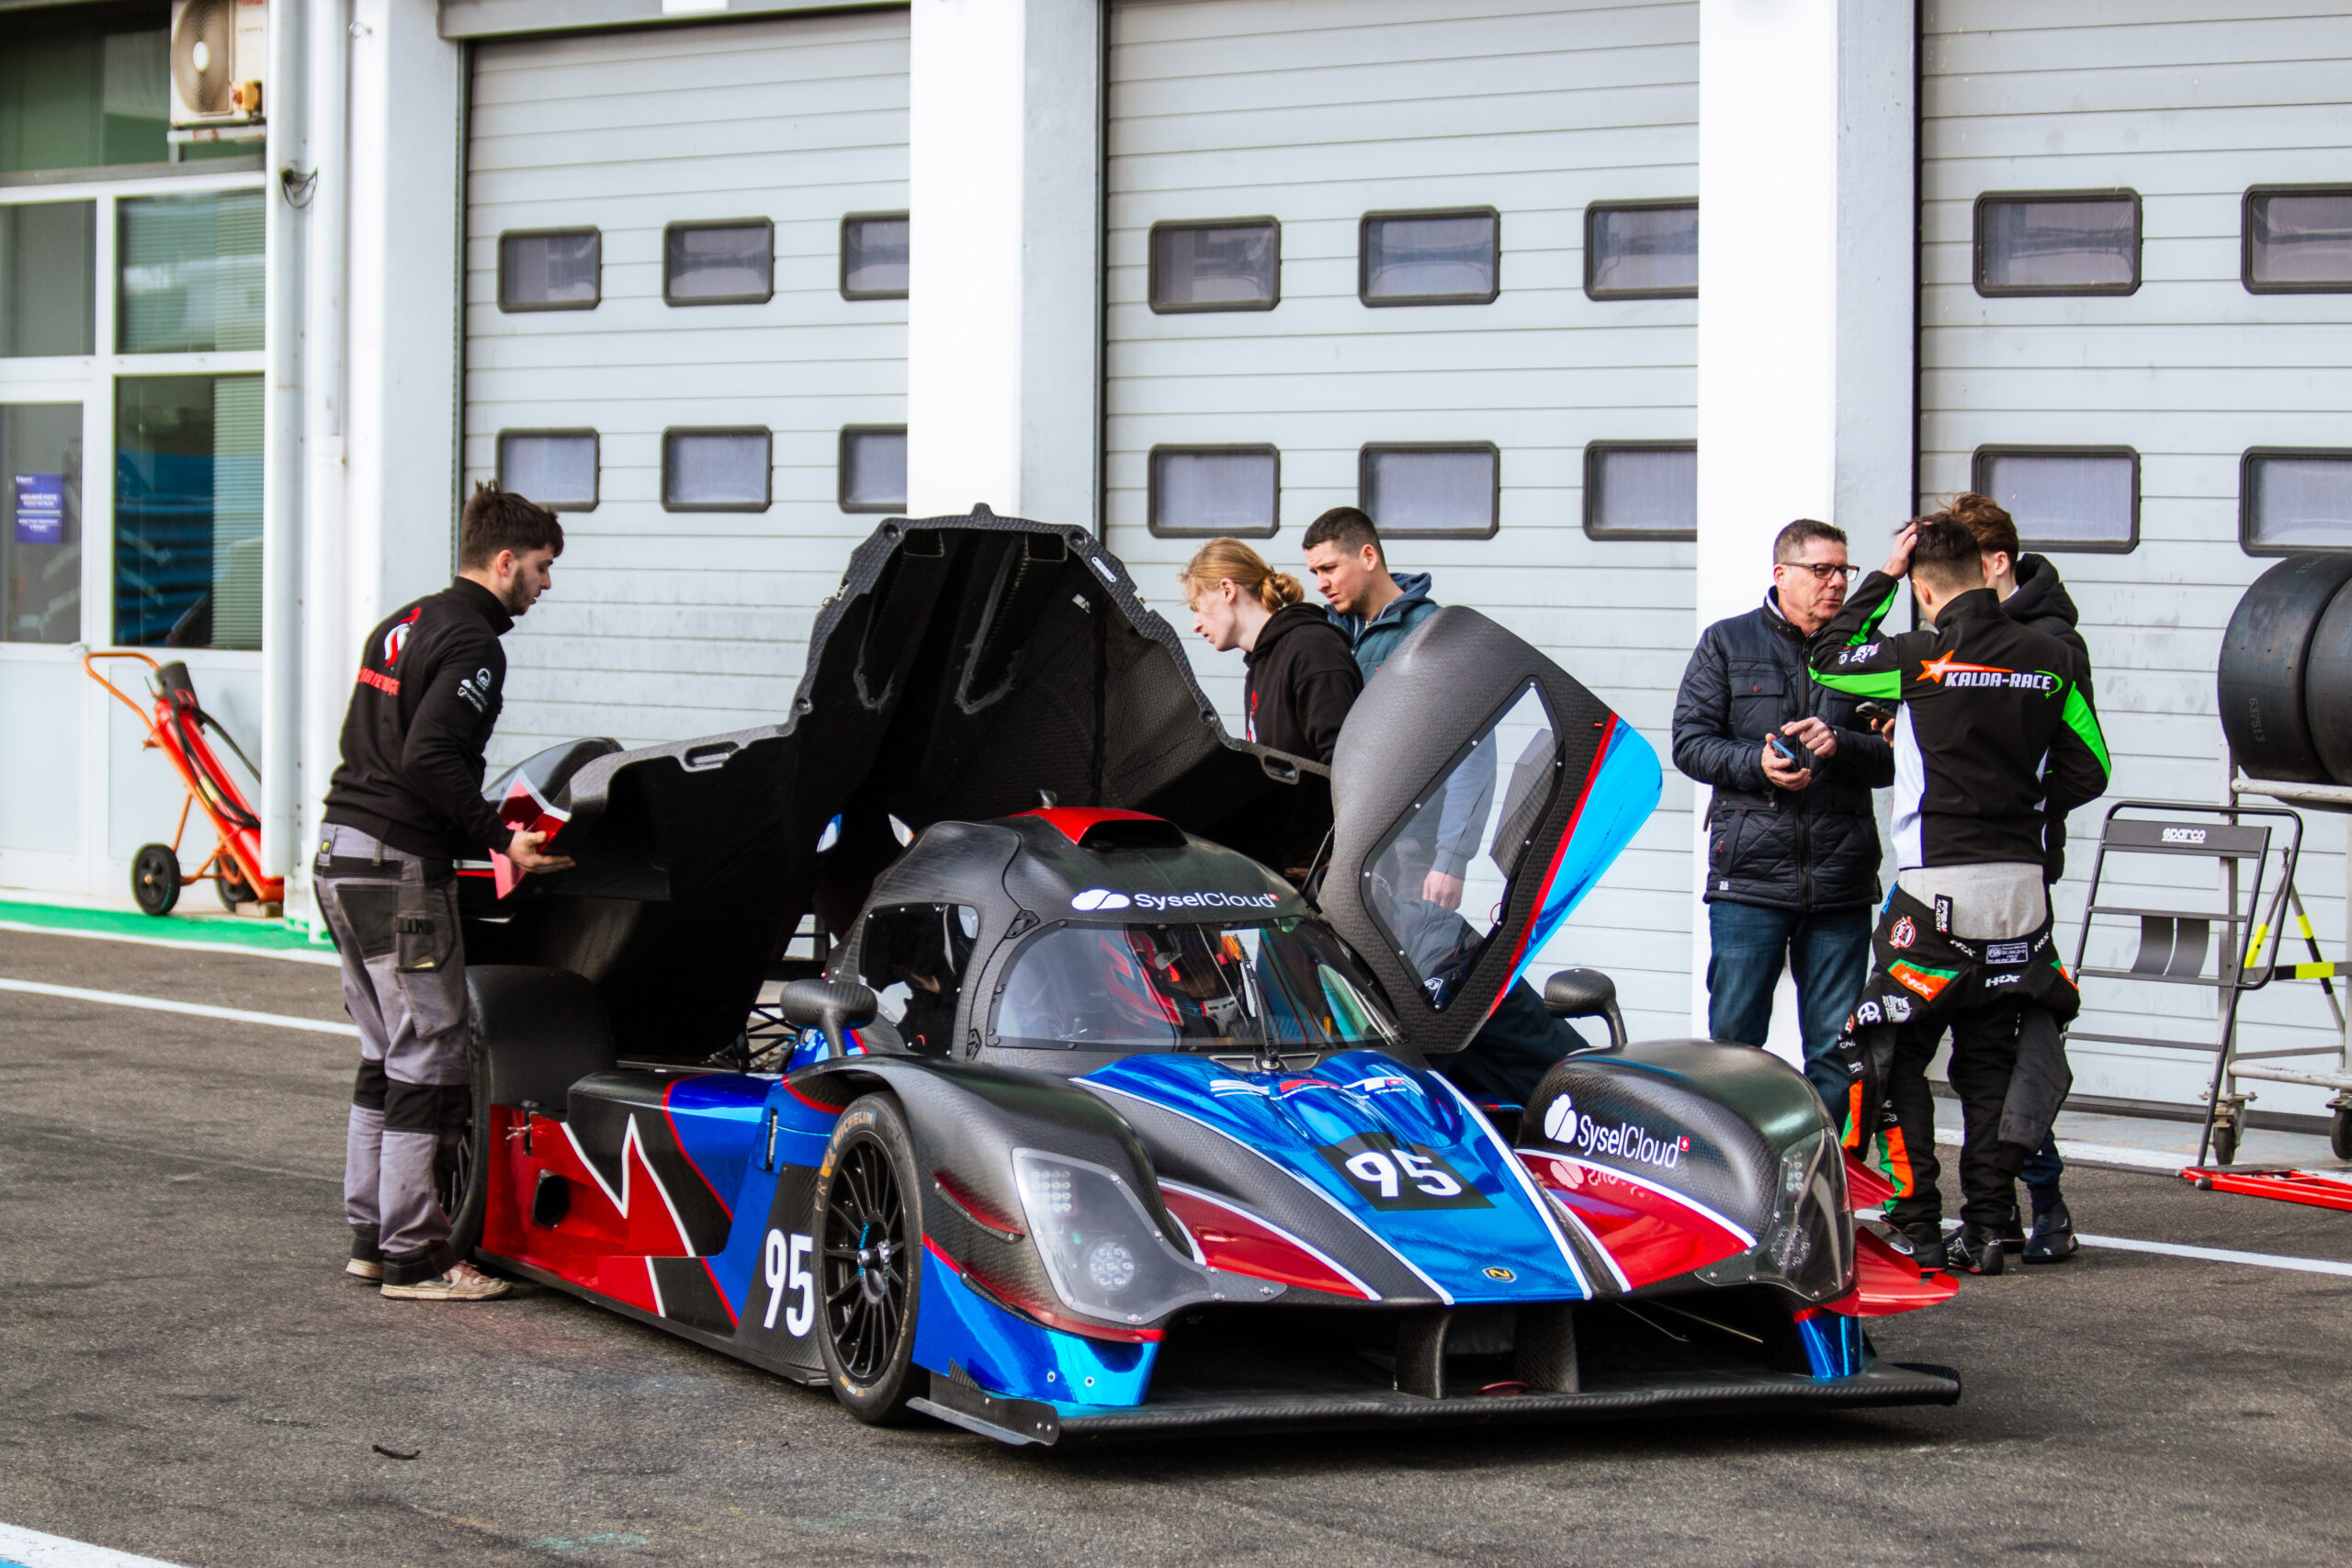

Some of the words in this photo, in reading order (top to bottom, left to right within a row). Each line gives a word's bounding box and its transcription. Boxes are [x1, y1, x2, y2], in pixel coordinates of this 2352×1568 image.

[1945, 671, 2052, 691] KALDA-RACE
[1133, 892, 1276, 911] SyselCloud
[1900, 972, 1935, 996] HRX
[1984, 974, 2021, 988] HRX
[832, 1110, 874, 1150] MICHELIN
[1577, 1114, 1681, 1168] SyselCloud
[1344, 1148, 1463, 1198] 95
[763, 1228, 815, 1337] 95
